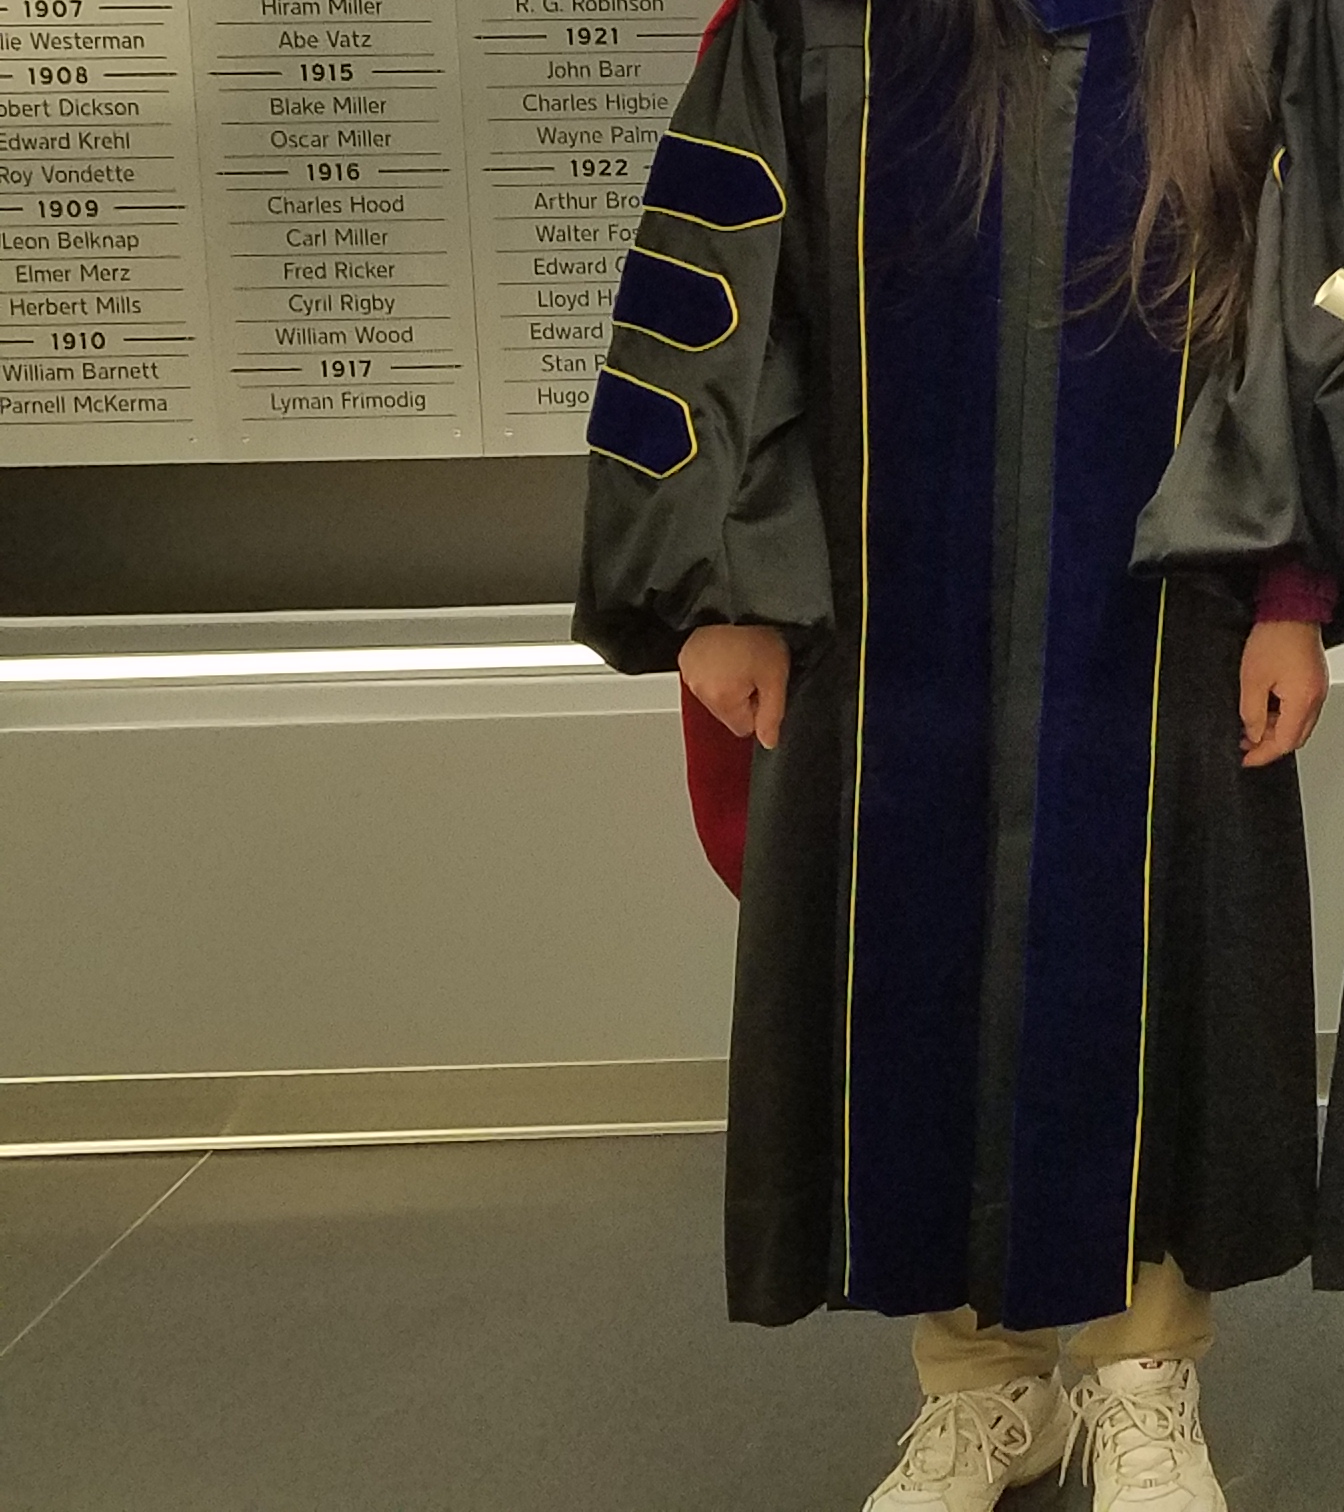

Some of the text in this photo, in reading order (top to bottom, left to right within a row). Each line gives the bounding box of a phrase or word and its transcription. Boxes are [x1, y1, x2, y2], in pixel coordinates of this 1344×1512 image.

[23, 0, 83, 19] 1907
[566, 26, 618, 46] 1921
[27, 65, 89, 86] 1908
[300, 62, 354, 82] 1915
[307, 162, 360, 182] 1916
[38, 199, 99, 219] 1909
[15, 263, 131, 284] Elmer Merz
[9, 296, 142, 317] Herbert Mills
[288, 293, 396, 317] Cyril Rigby
[51, 331, 106, 351] 1910
[321, 359, 372, 378] 1917
[270, 390, 426, 415] Lyman Frimodig
